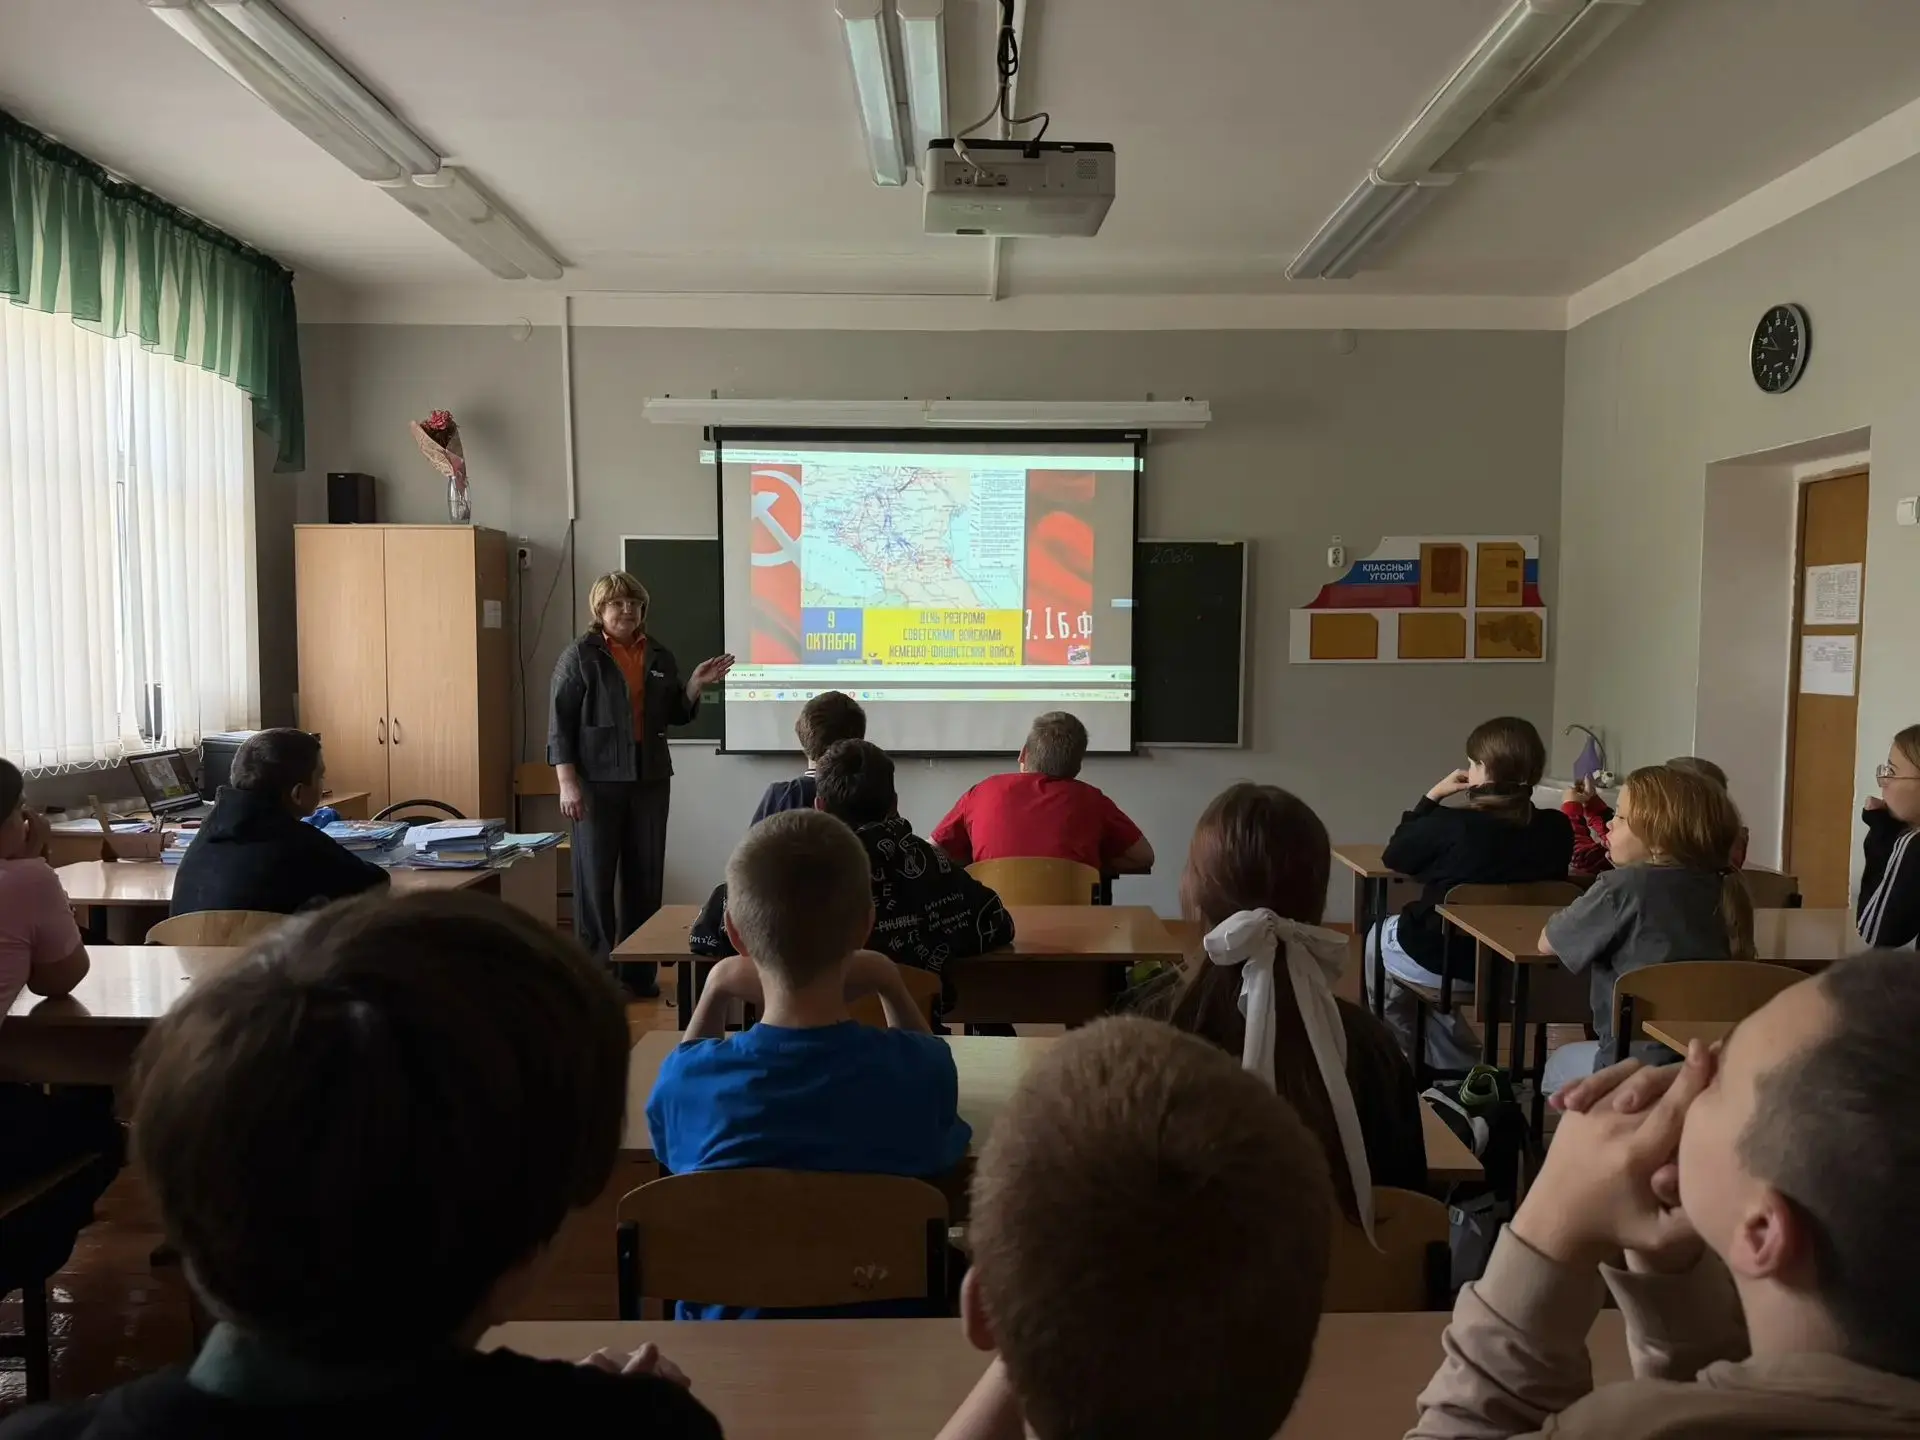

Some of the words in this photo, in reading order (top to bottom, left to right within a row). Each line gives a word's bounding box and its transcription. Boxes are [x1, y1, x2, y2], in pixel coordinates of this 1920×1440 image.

[1362, 561, 1413, 572] КЛАССНЫЙ
[1369, 572, 1405, 581] УГОЛОК
[827, 610, 836, 629] 9
[806, 632, 857, 651] ОКТЯБРЯ
